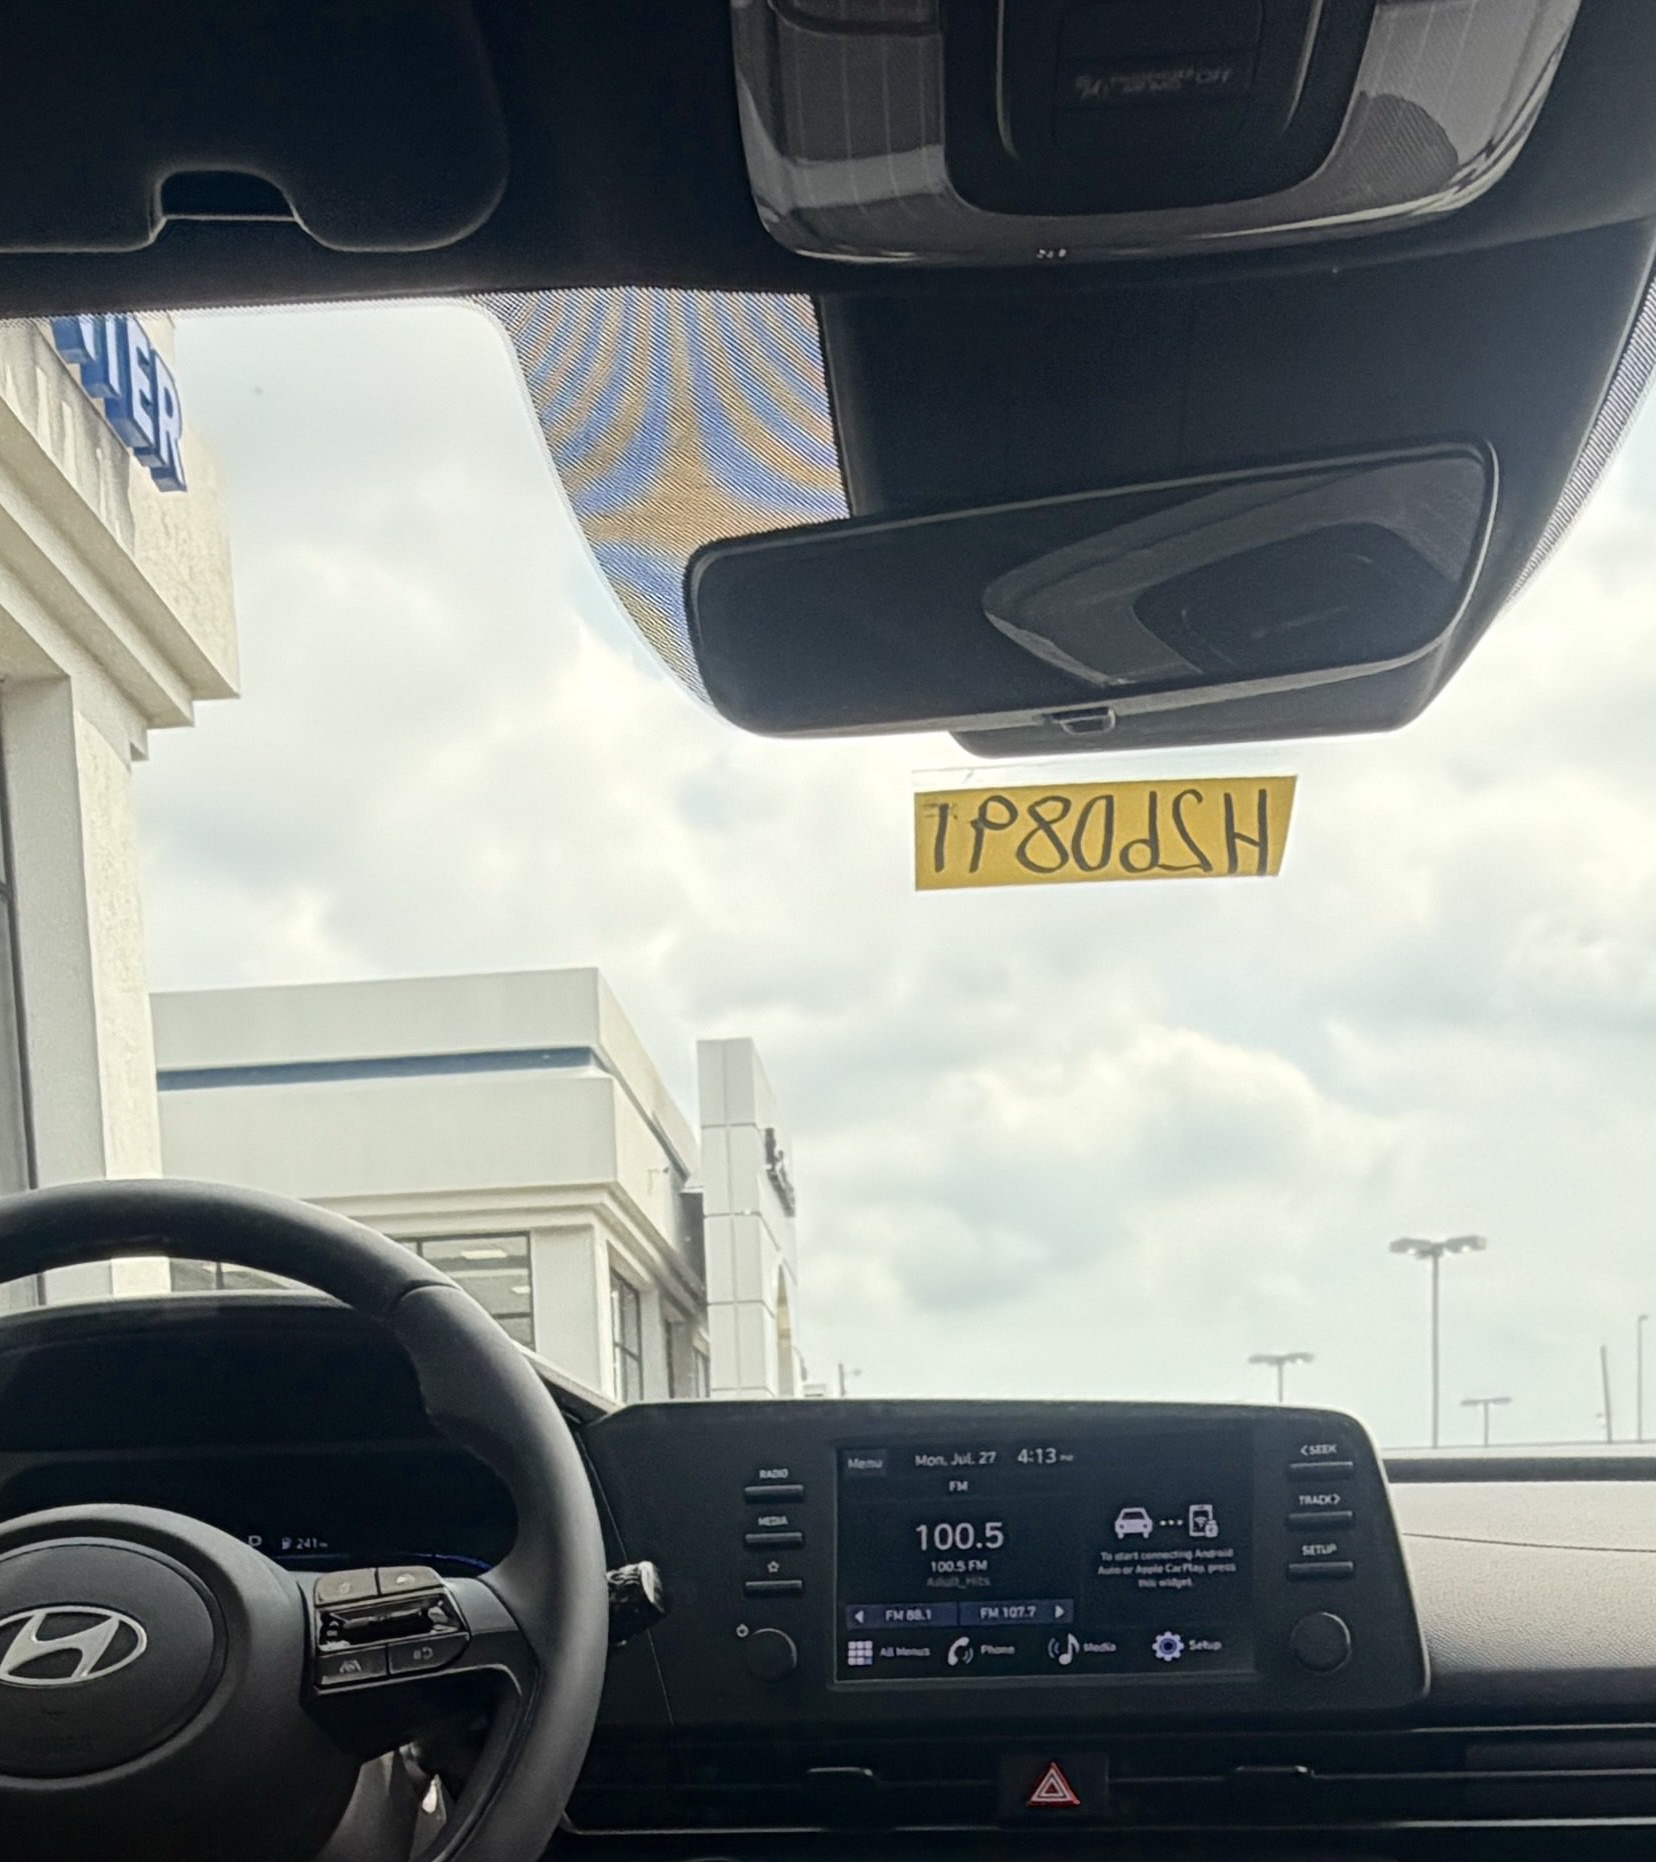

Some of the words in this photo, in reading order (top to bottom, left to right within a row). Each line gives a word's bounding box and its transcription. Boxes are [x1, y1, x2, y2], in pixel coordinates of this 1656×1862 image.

[1309, 1444, 1338, 1455] SEEK
[978, 1451, 997, 1464] 27
[1017, 1448, 1057, 1464] 4:13
[848, 1459, 883, 1470] Menu
[759, 1468, 789, 1479] RADIO
[949, 1481, 969, 1492] FM
[758, 1515, 788, 1526] MEDIA
[915, 1522, 1005, 1551] 100.5
[1302, 1543, 1337, 1556] SETUP
[931, 1560, 965, 1572] 100.5
[968, 1560, 988, 1571] FM
[885, 1610, 904, 1621] FM
[980, 1608, 999, 1619] FM
[1002, 1606, 1037, 1618] 107.7
[980, 1644, 1015, 1655] Phone
[1188, 1639, 1222, 1651] Setup
